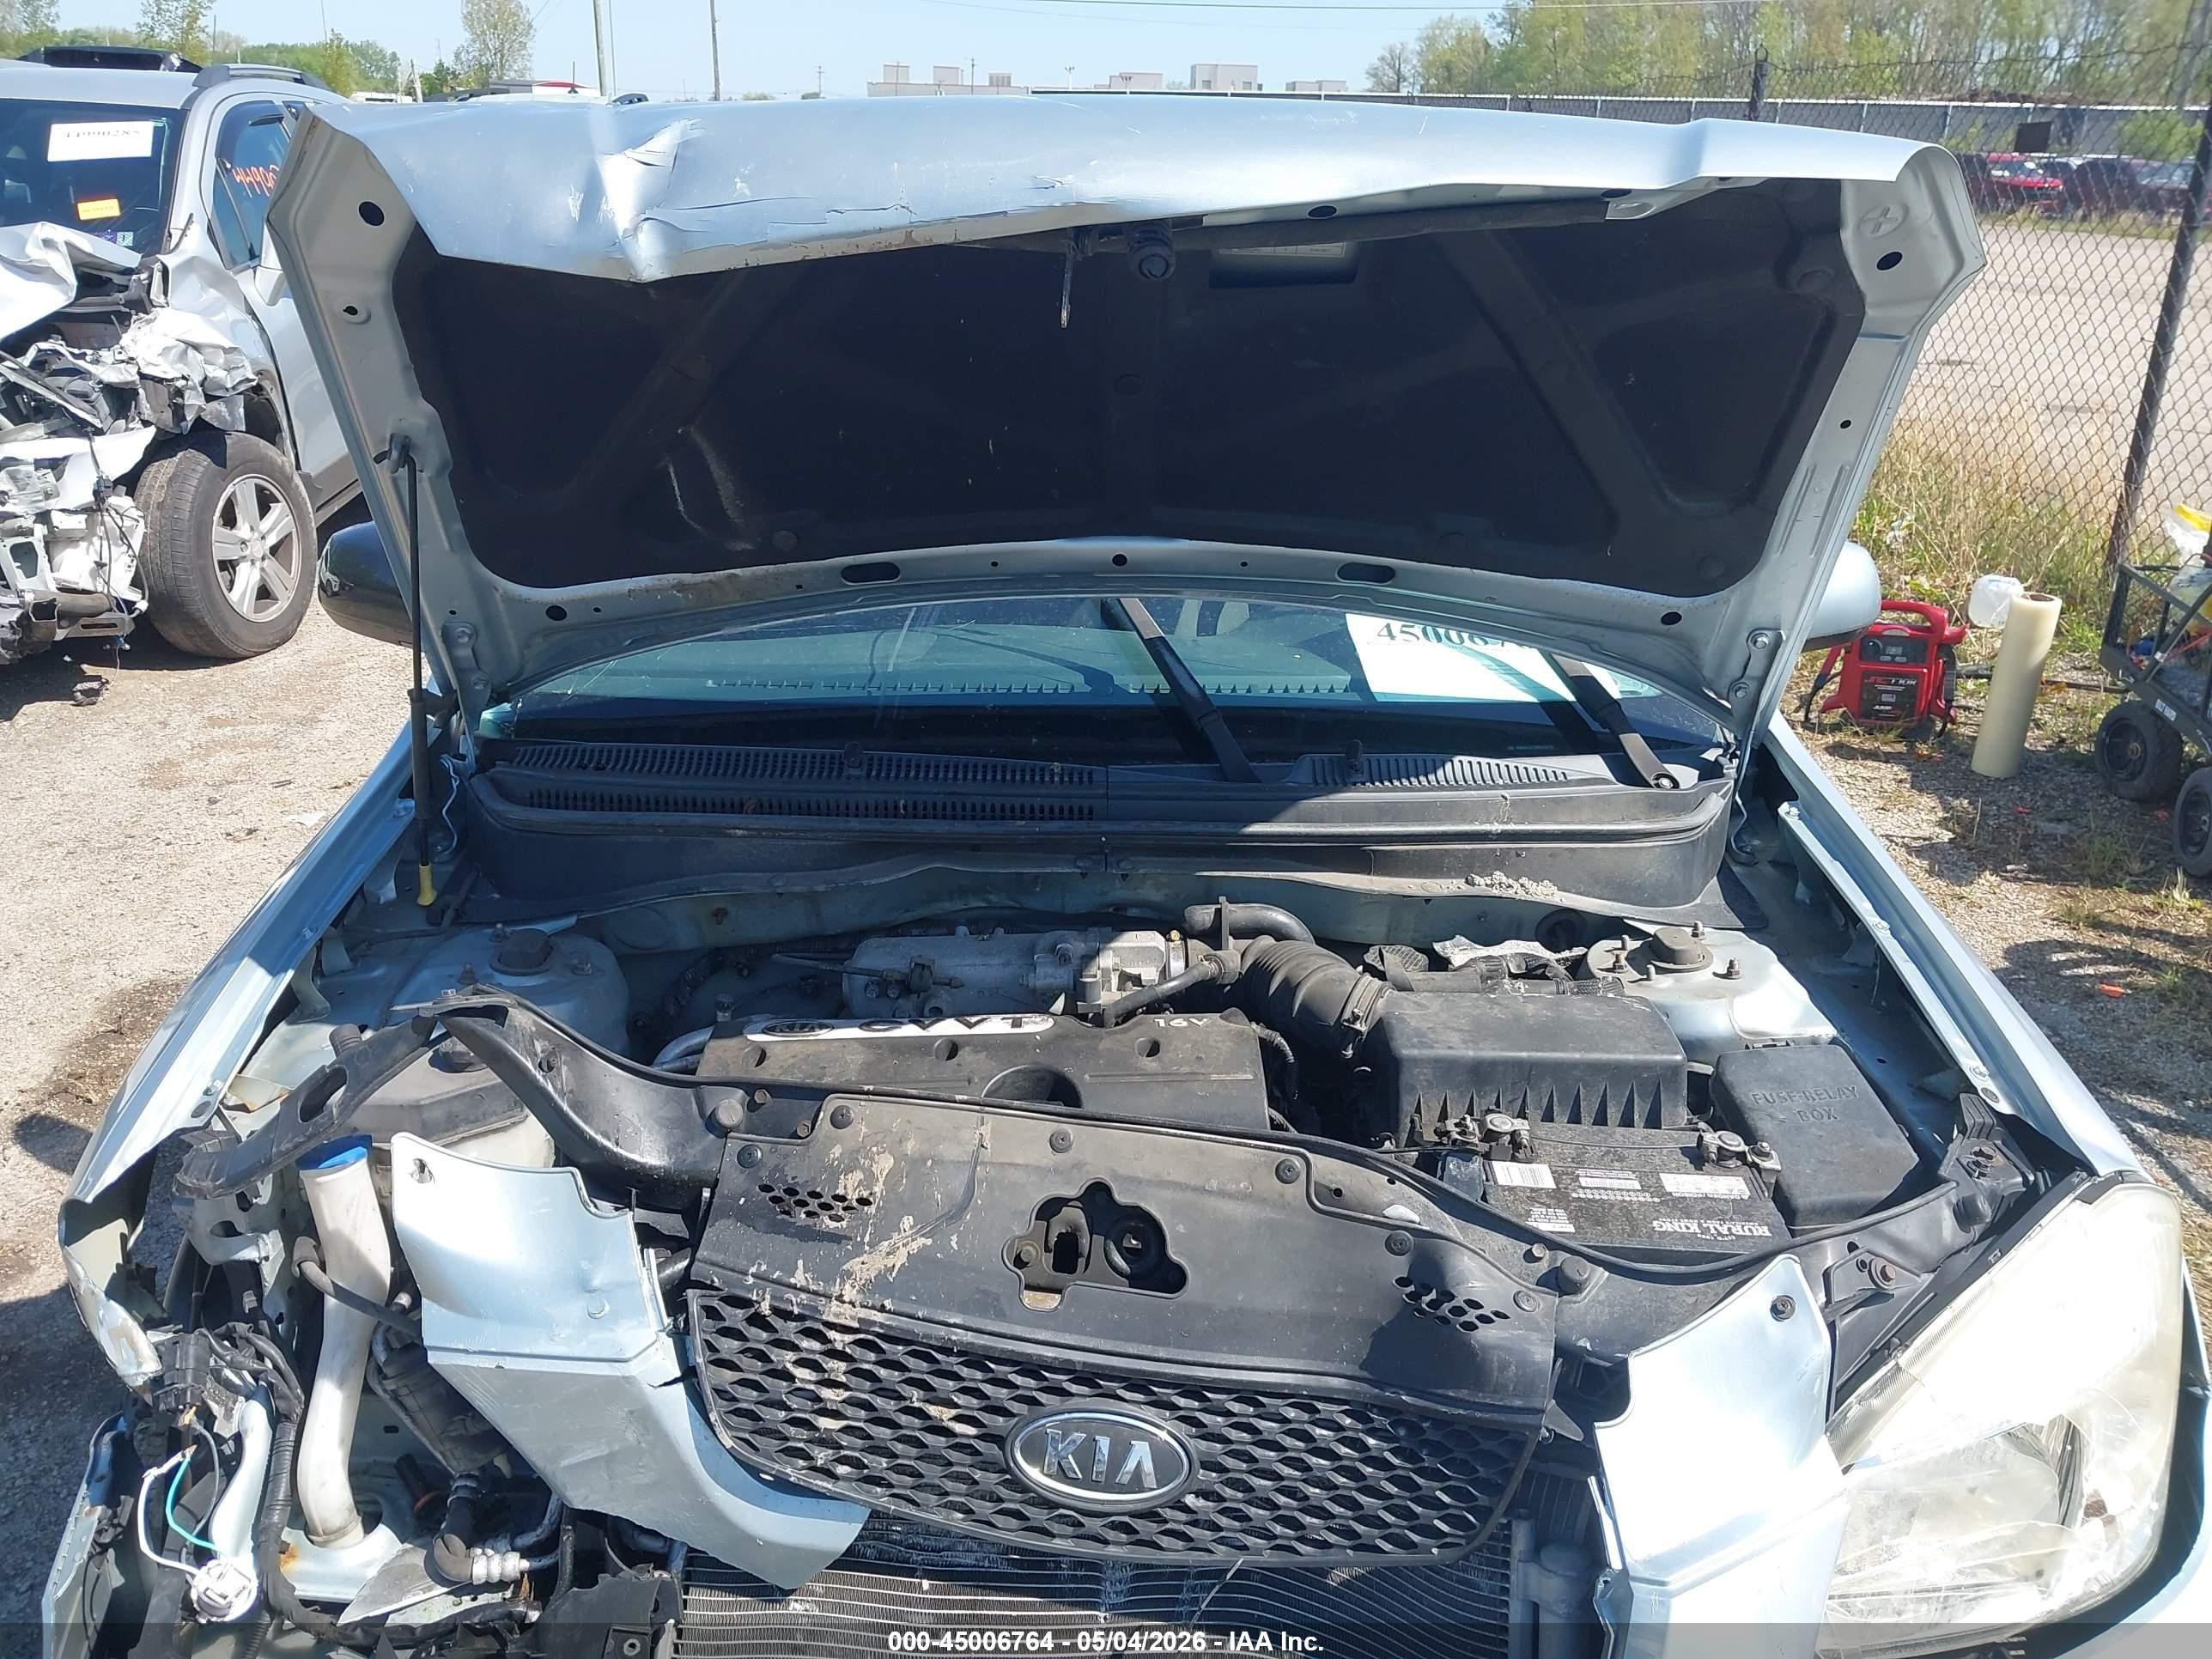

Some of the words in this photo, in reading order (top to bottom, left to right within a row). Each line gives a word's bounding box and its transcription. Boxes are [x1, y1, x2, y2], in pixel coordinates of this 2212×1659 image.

[1153, 1018, 1209, 1027] 16V
[1794, 1107, 1839, 1122] BOX
[1652, 1220, 1702, 1234] KING
[1702, 1223, 1772, 1237] RURAL
[1043, 1428, 1158, 1488] KIA
